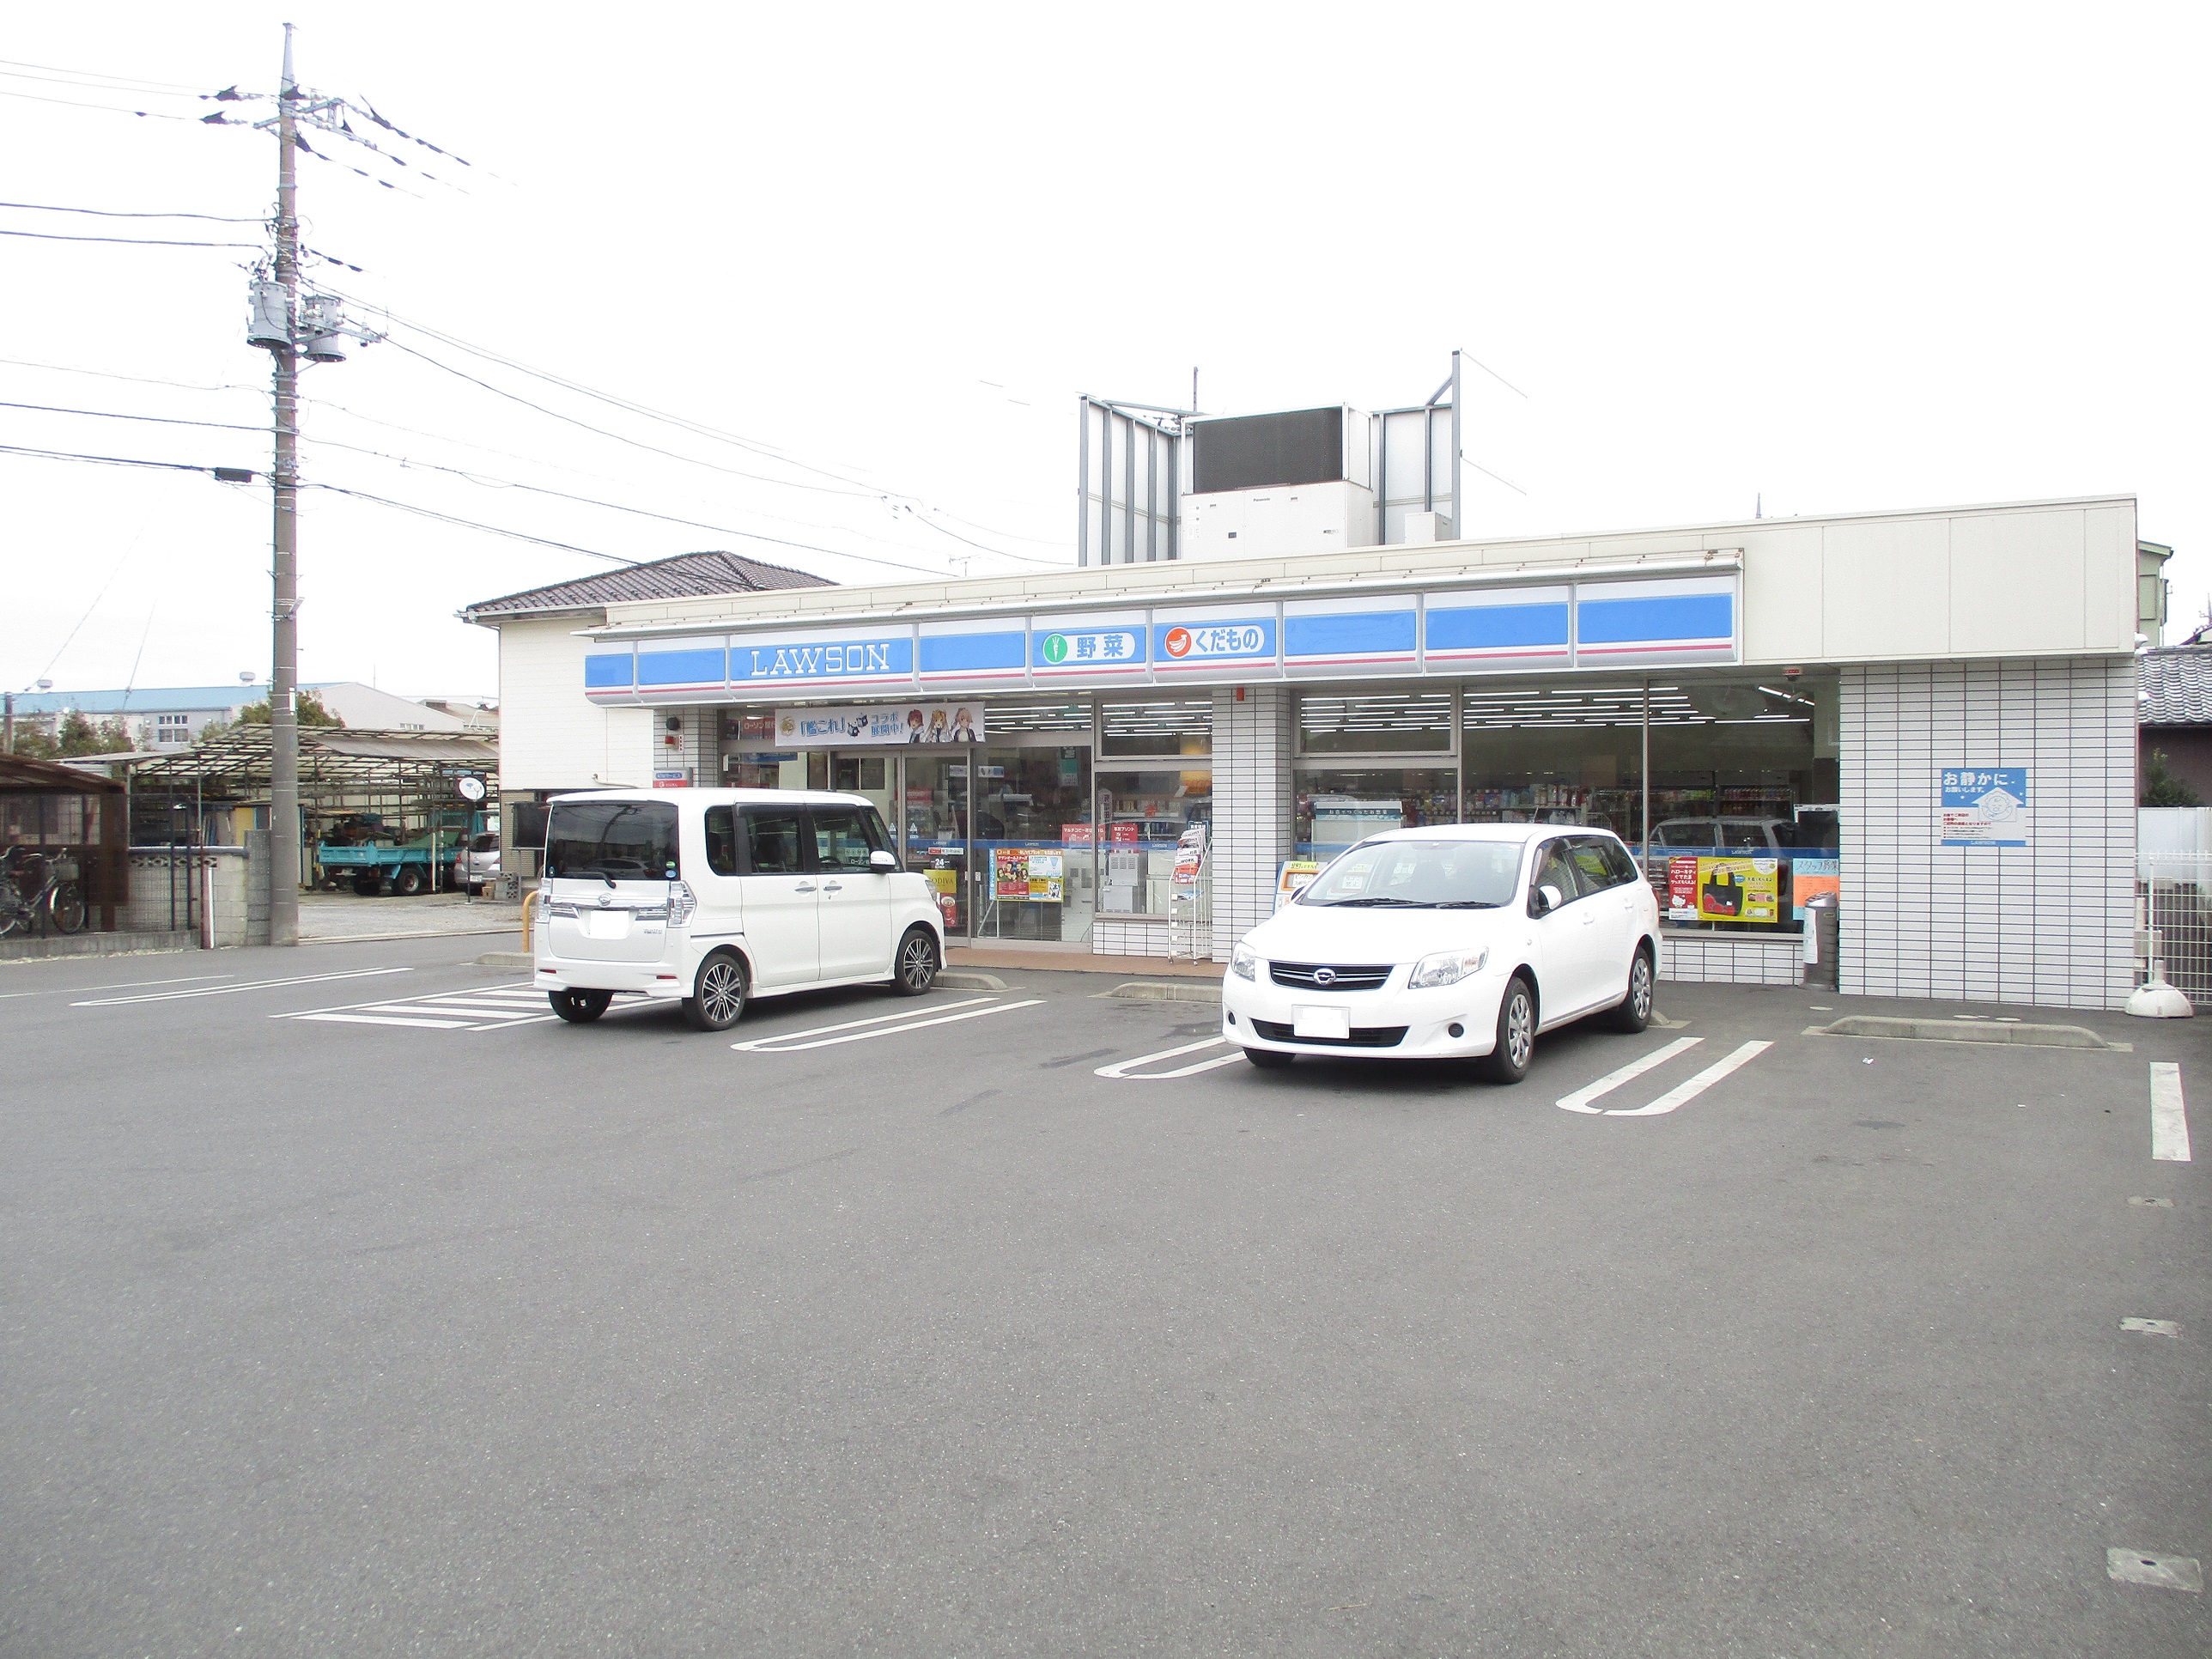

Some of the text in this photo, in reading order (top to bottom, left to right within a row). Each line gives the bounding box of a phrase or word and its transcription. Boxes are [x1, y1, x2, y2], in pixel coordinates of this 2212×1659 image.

[1076, 635, 1124, 659] 野菜
[1195, 629, 1260, 653] くだもの
[750, 643, 890, 677] LAWSON
[871, 711, 899, 723] コラボ
[1943, 772, 2009, 787] お静かに
